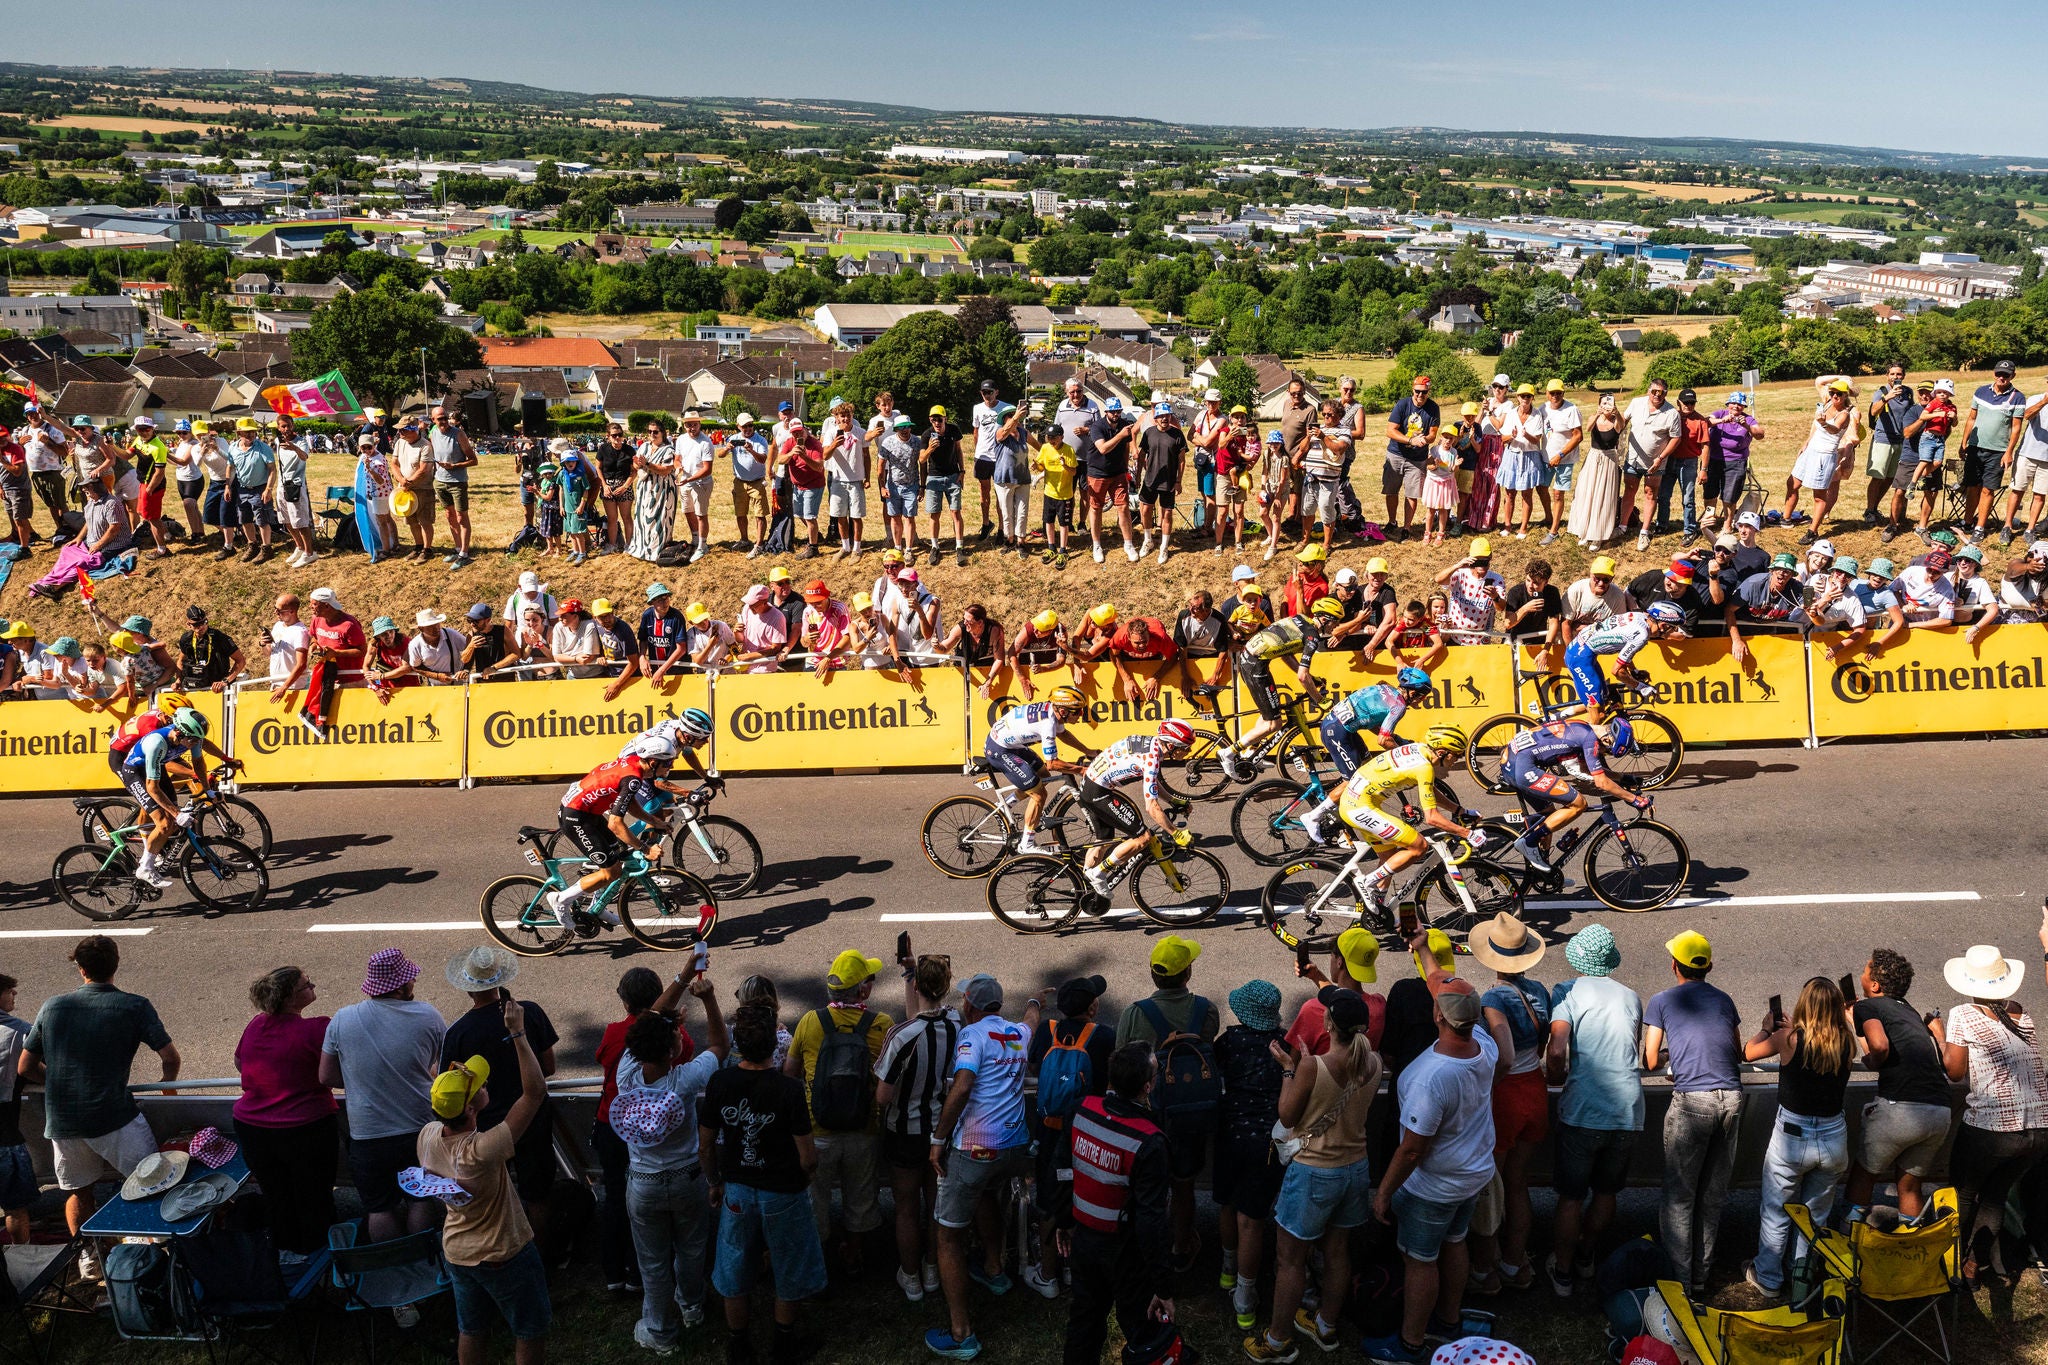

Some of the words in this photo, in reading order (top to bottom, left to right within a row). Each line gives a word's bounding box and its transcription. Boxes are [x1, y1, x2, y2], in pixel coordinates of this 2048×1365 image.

[648, 636, 670, 644] QATAR
[1622, 643, 1636, 658] BORA
[1573, 666, 1594, 691] BORA
[1831, 656, 2046, 704] Continental
[484, 705, 654, 748] Continental
[730, 699, 910, 742] Continental
[980, 781, 989, 789] 21
[1119, 803, 1135, 822] VISMA
[1354, 812, 1380, 830] UAE
[1508, 814, 1522, 822] 191
[95, 826, 106, 838] 151
[573, 825, 594, 852] ARKEA
[159, 859, 172, 874] VAN
[168, 841, 184, 863] RYSEL
[525, 851, 537, 865] 131
[1106, 852, 1144, 890] cervélo
[1074, 1135, 1101, 1164] ARBITRE
[1099, 1148, 1121, 1172] MOTO
